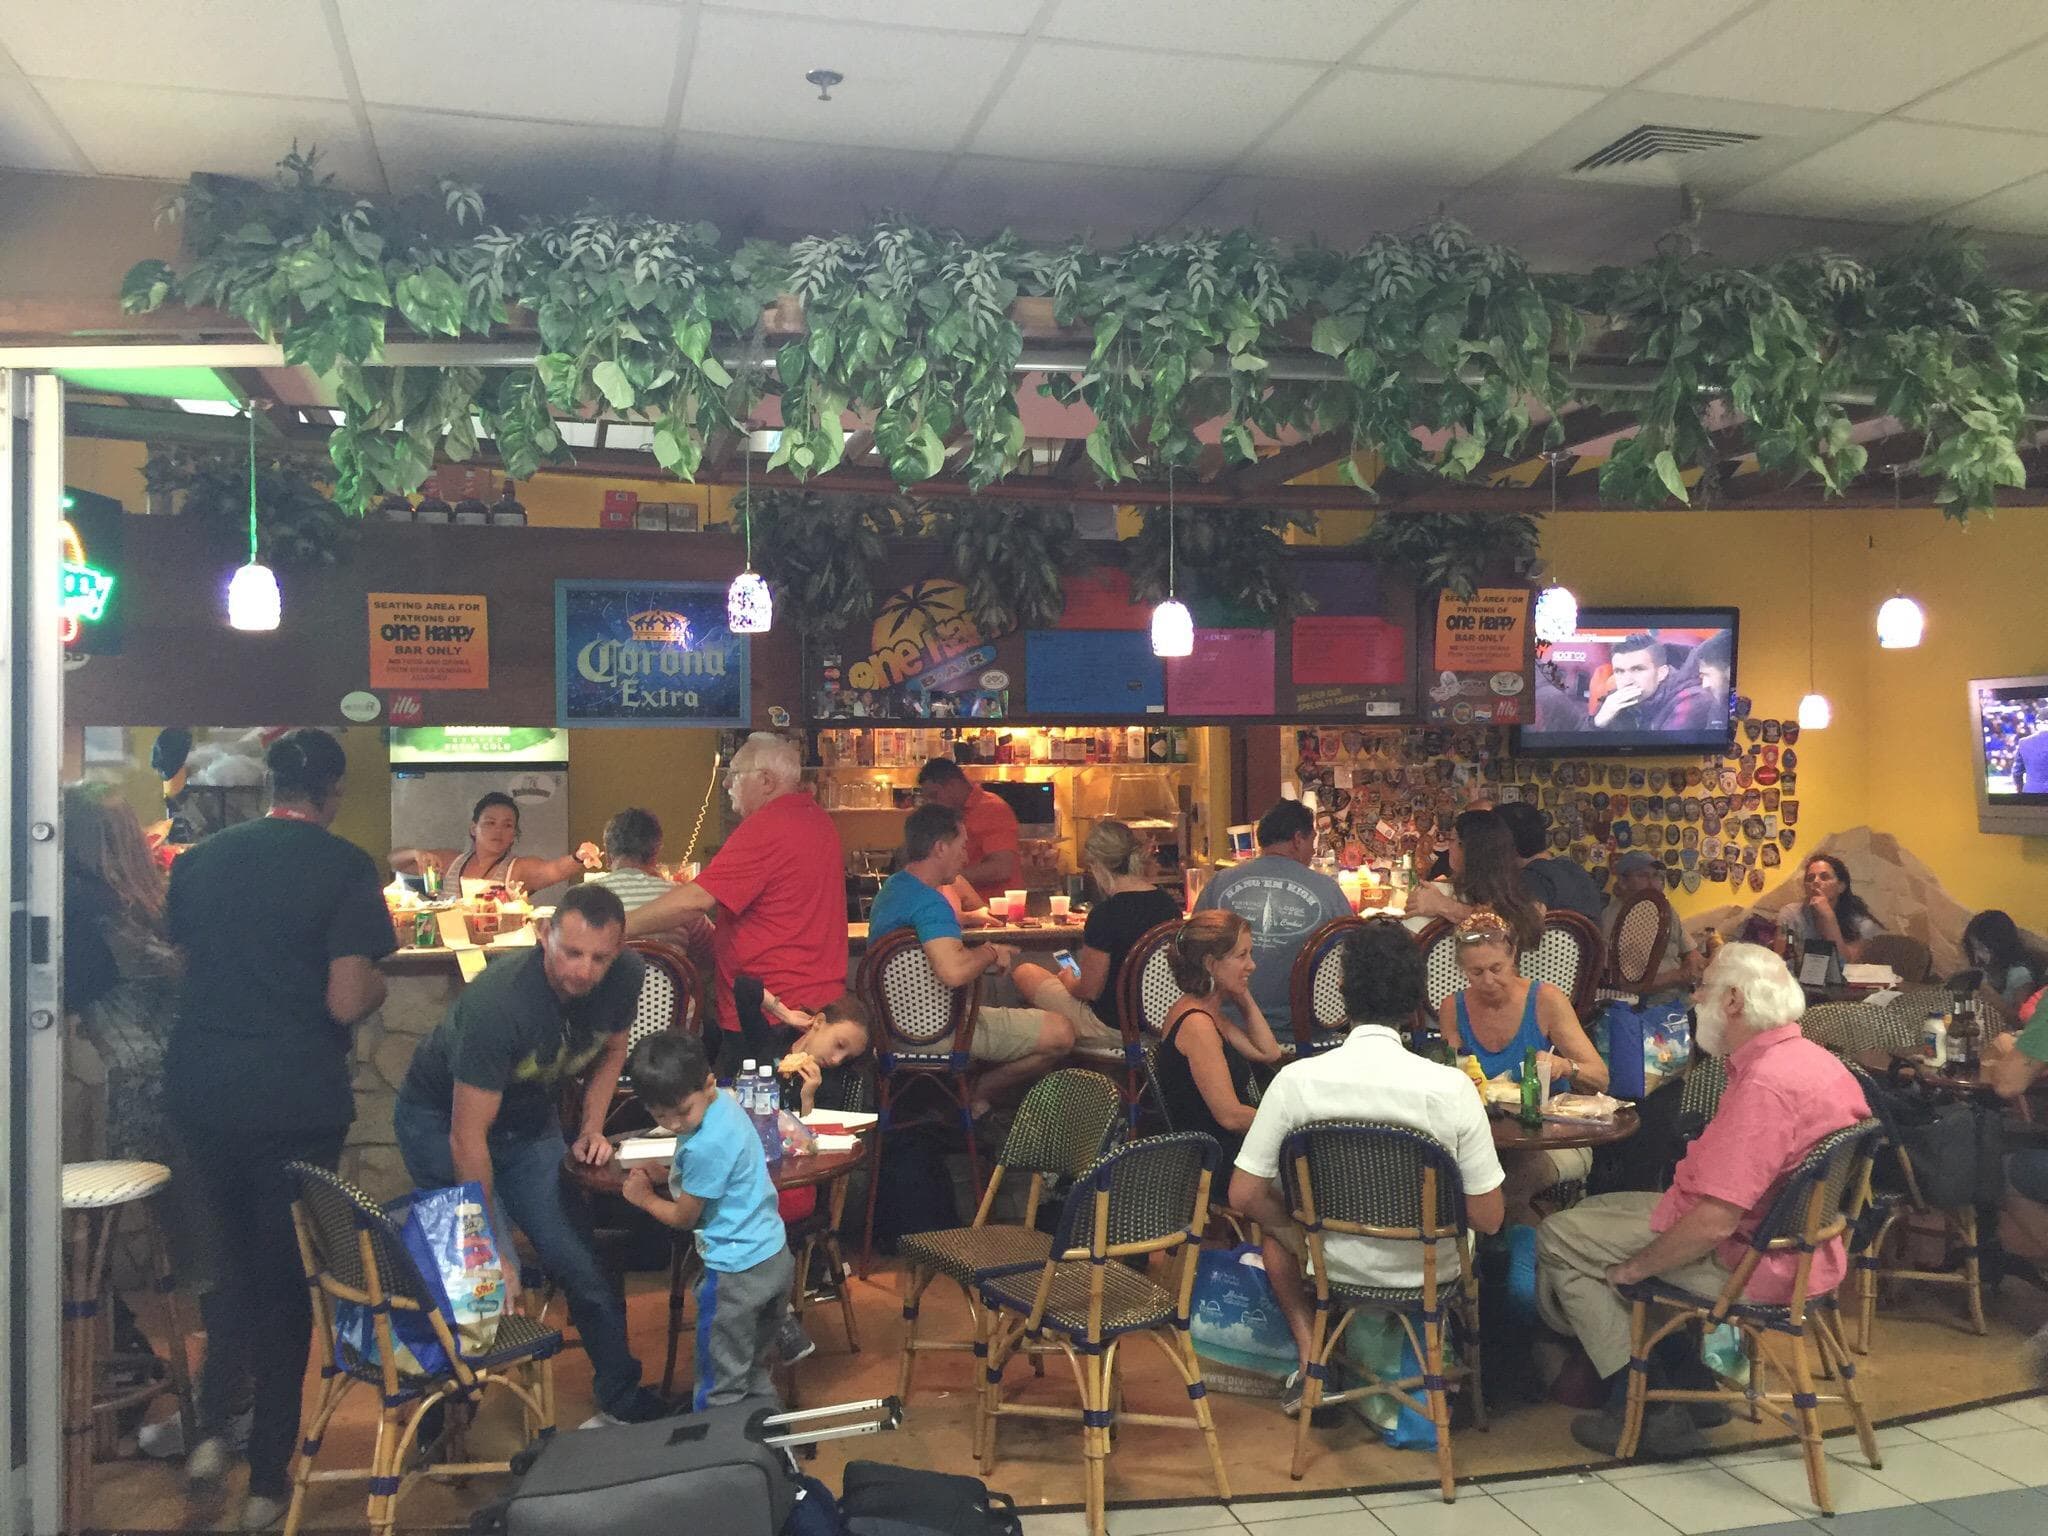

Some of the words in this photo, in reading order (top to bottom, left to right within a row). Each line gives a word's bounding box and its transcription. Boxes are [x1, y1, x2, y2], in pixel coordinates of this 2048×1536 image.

[374, 602, 422, 610] SEATING
[425, 602, 455, 610] AREA
[458, 603, 480, 611] FOR
[393, 614, 445, 622] PATRONS
[1455, 634, 1474, 642] BAR
[1478, 634, 1506, 642] ONLY
[395, 646, 422, 655] BAR
[426, 646, 462, 655] ONLY
[577, 639, 726, 688] Corona
[621, 676, 699, 708] Extra
